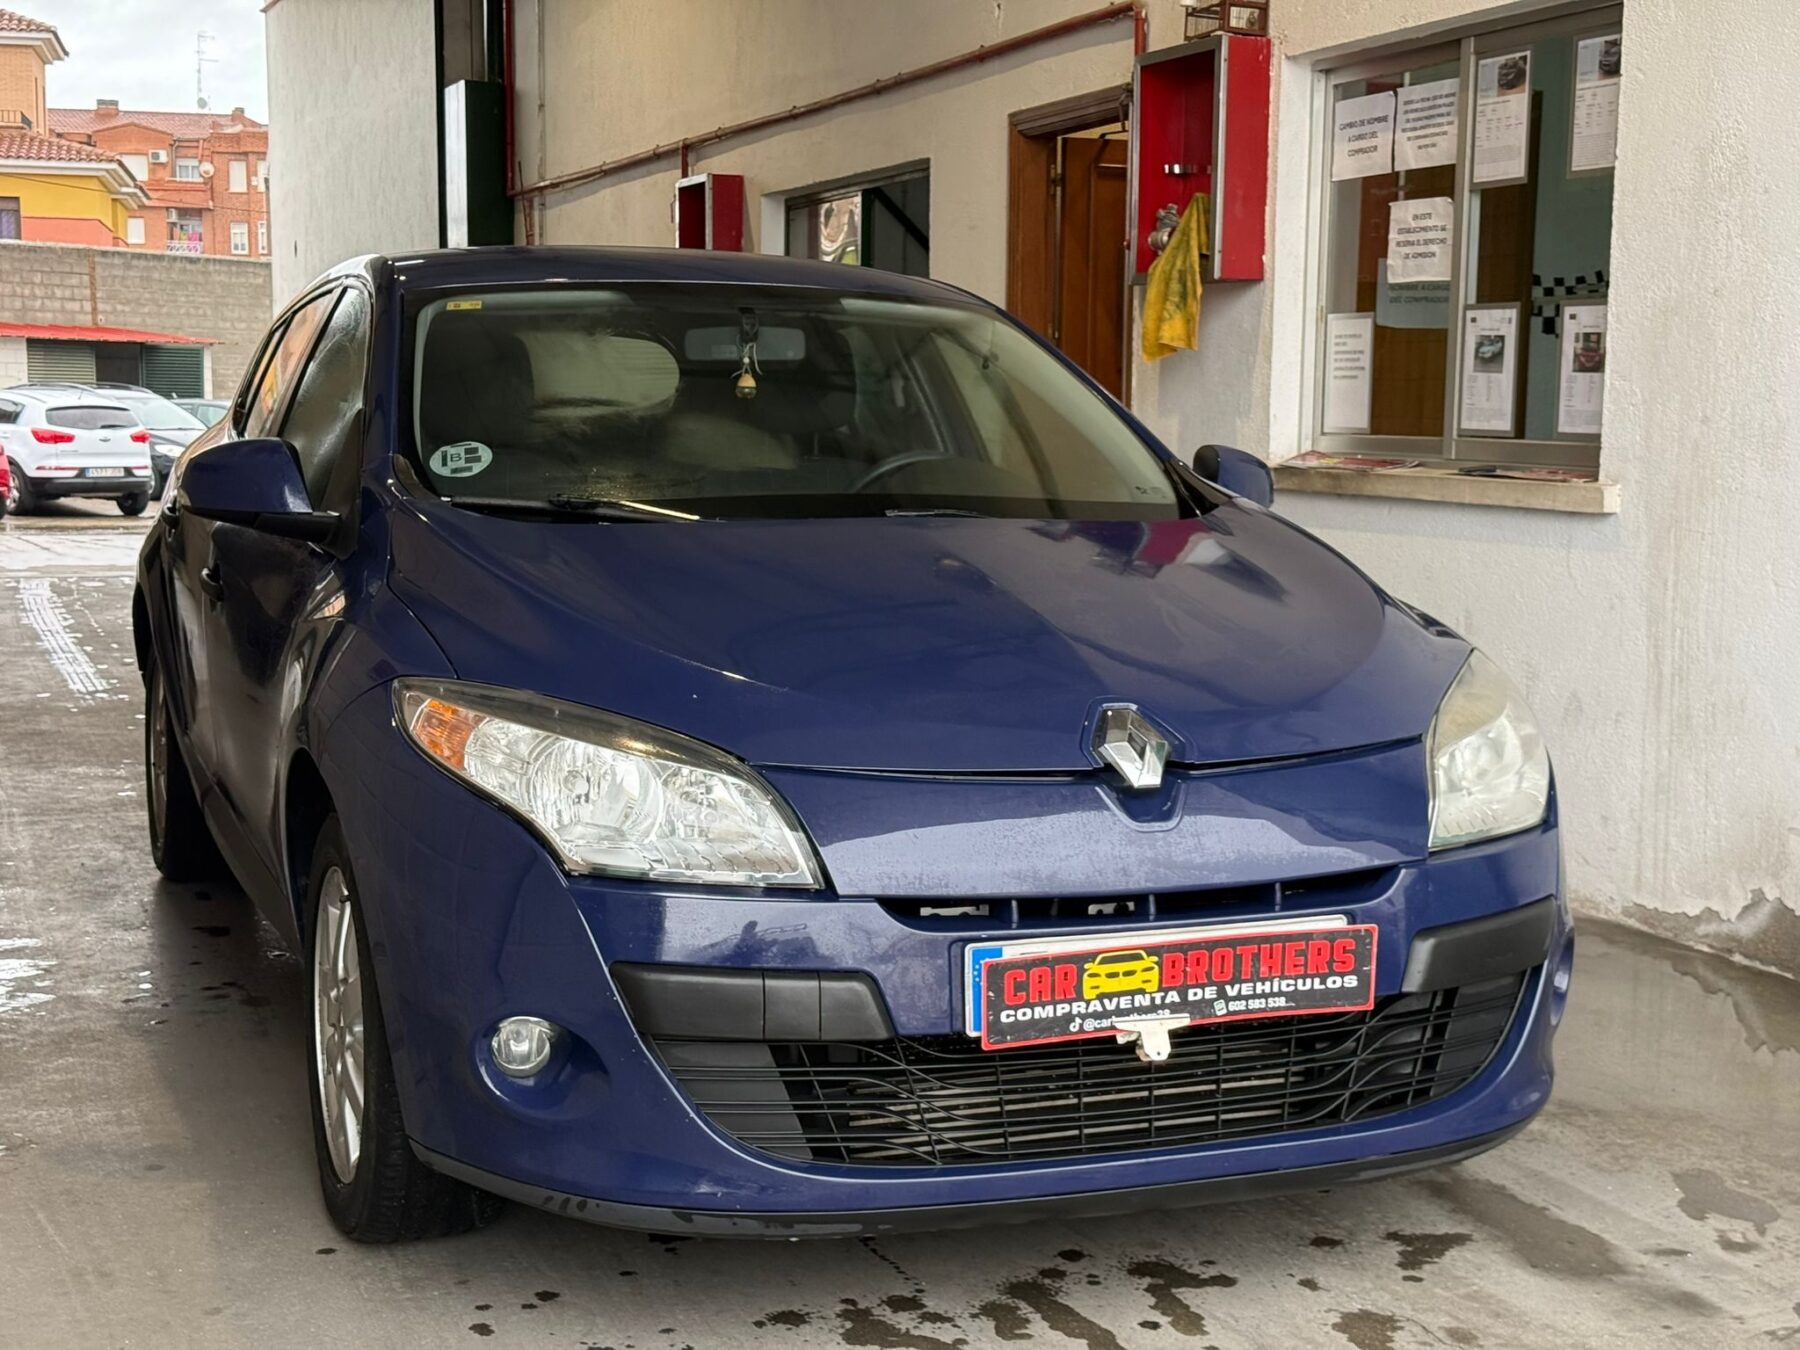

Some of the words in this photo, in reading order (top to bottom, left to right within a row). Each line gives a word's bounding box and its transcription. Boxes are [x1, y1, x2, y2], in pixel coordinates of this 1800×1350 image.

[450, 452, 462, 463] B
[1003, 963, 1078, 1006] CAR
[1161, 937, 1357, 988] BROTHERS
[1000, 991, 1181, 1023] COMPRAVENTA
[1187, 986, 1218, 1002] DE
[1224, 975, 1359, 998] VEHÍCULOS
